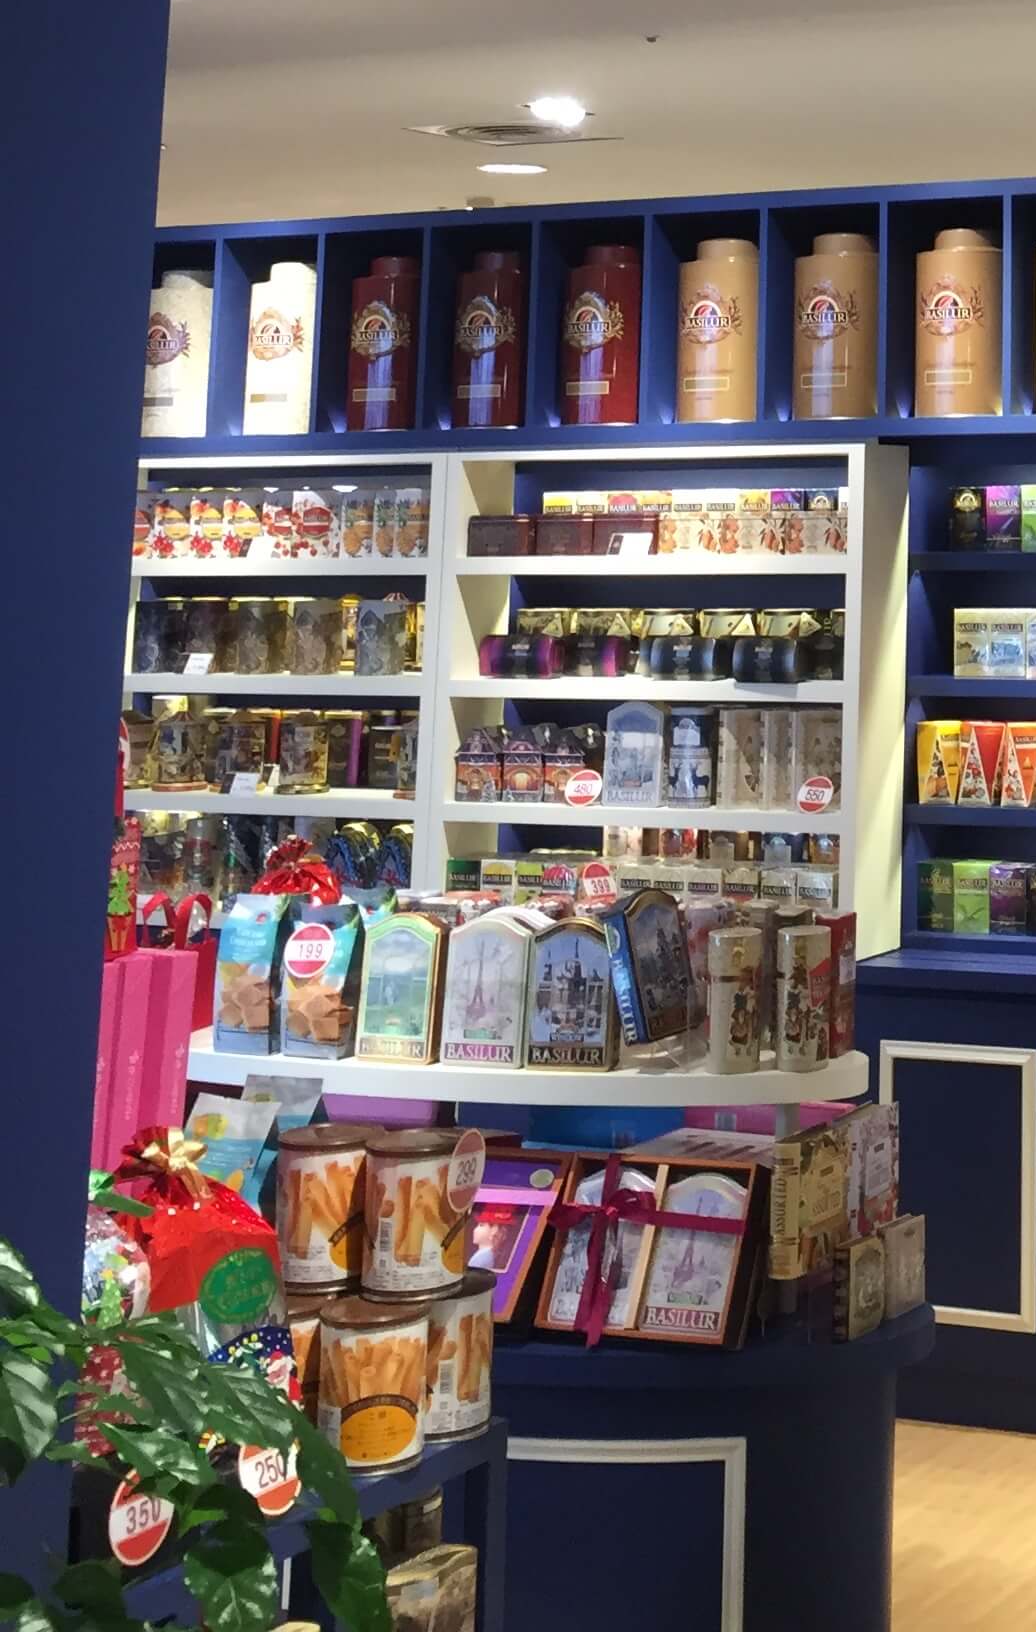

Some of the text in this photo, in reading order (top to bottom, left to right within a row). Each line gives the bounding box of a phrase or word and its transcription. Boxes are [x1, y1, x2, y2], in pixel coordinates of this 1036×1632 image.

[686, 317, 729, 328] BASILUR
[803, 312, 847, 323] BASILUR
[928, 309, 970, 320] BASILUR
[357, 331, 398, 341] BASILUR
[460, 327, 501, 338] BASILUR
[567, 322, 610, 334] BASILUR
[606, 790, 654, 802] BASILUR
[591, 878, 611, 895] 399
[298, 943, 324, 960] 199
[446, 1042, 512, 1062] BASILUR
[531, 1046, 600, 1065] BASILUR
[455, 1155, 478, 1186] 299
[774, 1177, 788, 1236] ASSORTED
[645, 1306, 716, 1330] BASILUR
[254, 1453, 287, 1489] 250
[126, 1497, 161, 1534] 350
